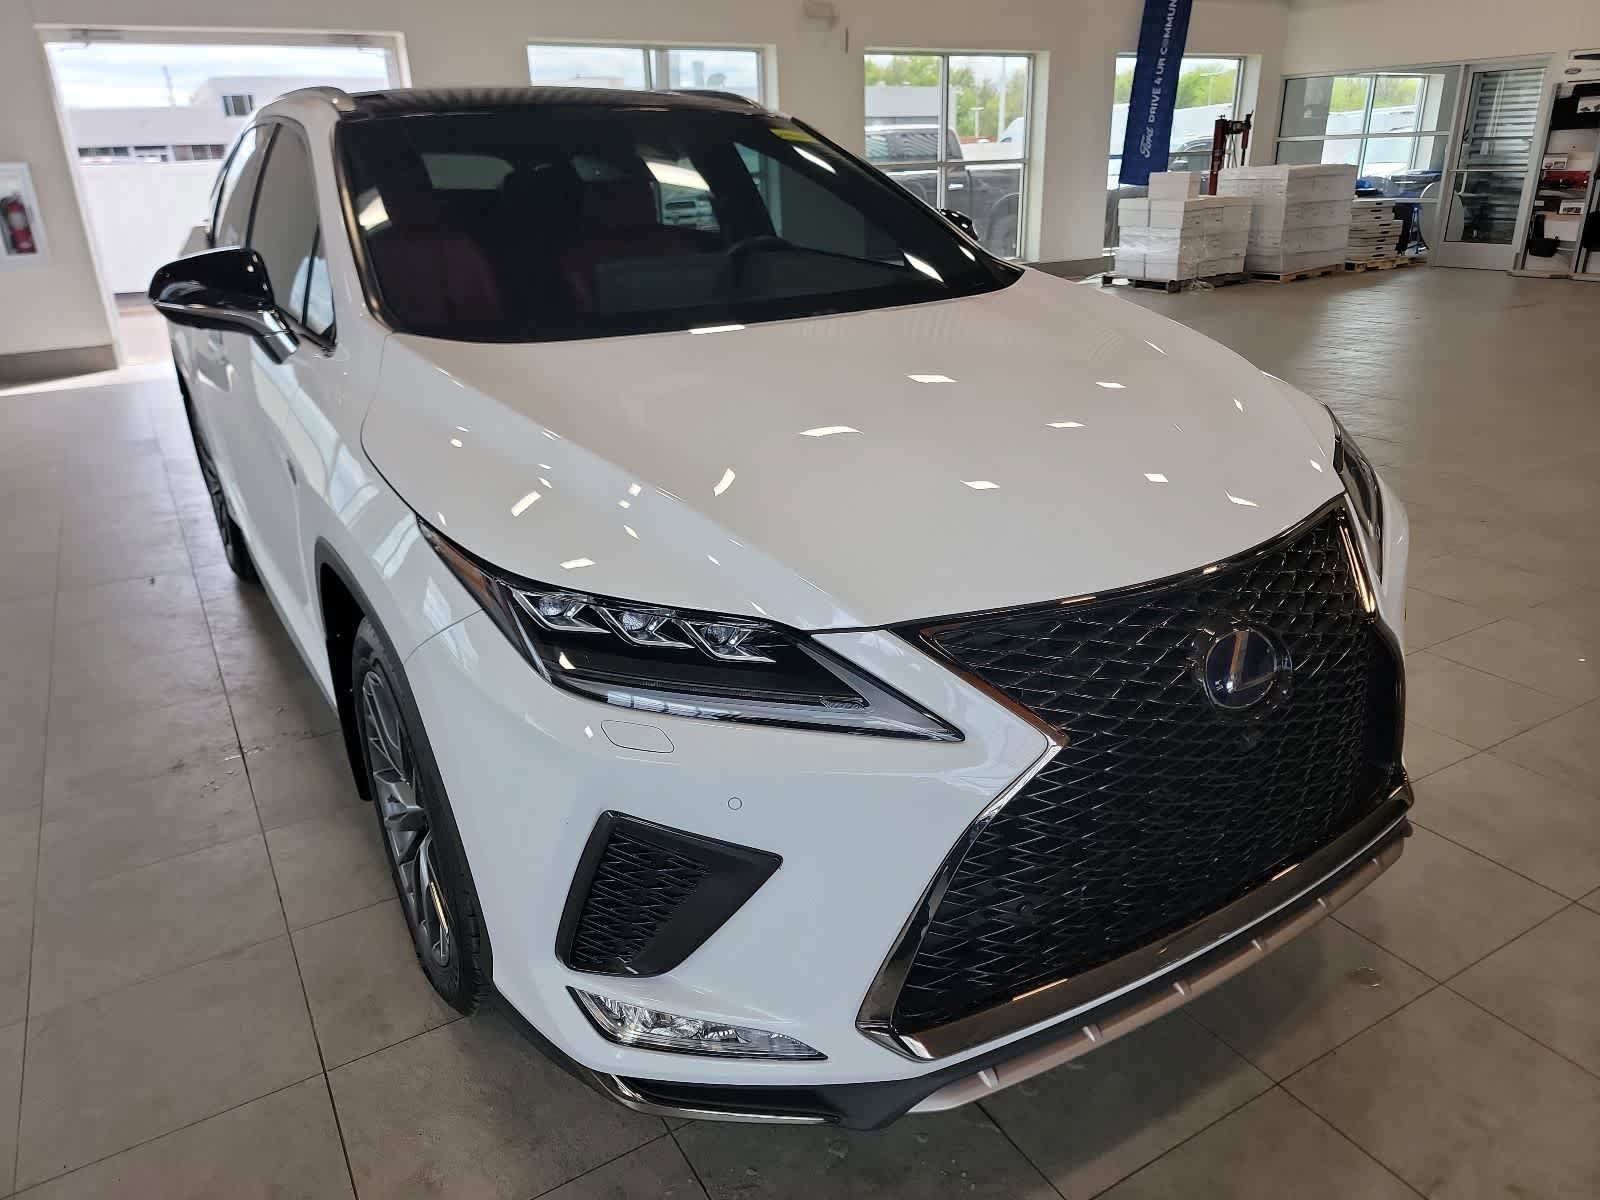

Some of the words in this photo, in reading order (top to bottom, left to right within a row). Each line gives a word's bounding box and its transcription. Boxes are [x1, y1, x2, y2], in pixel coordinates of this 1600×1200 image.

[1156, 58, 1166, 75] UR
[1154, 77, 1163, 85] 4
[1148, 88, 1161, 123] DRIVE
[1140, 126, 1153, 158] Ford
